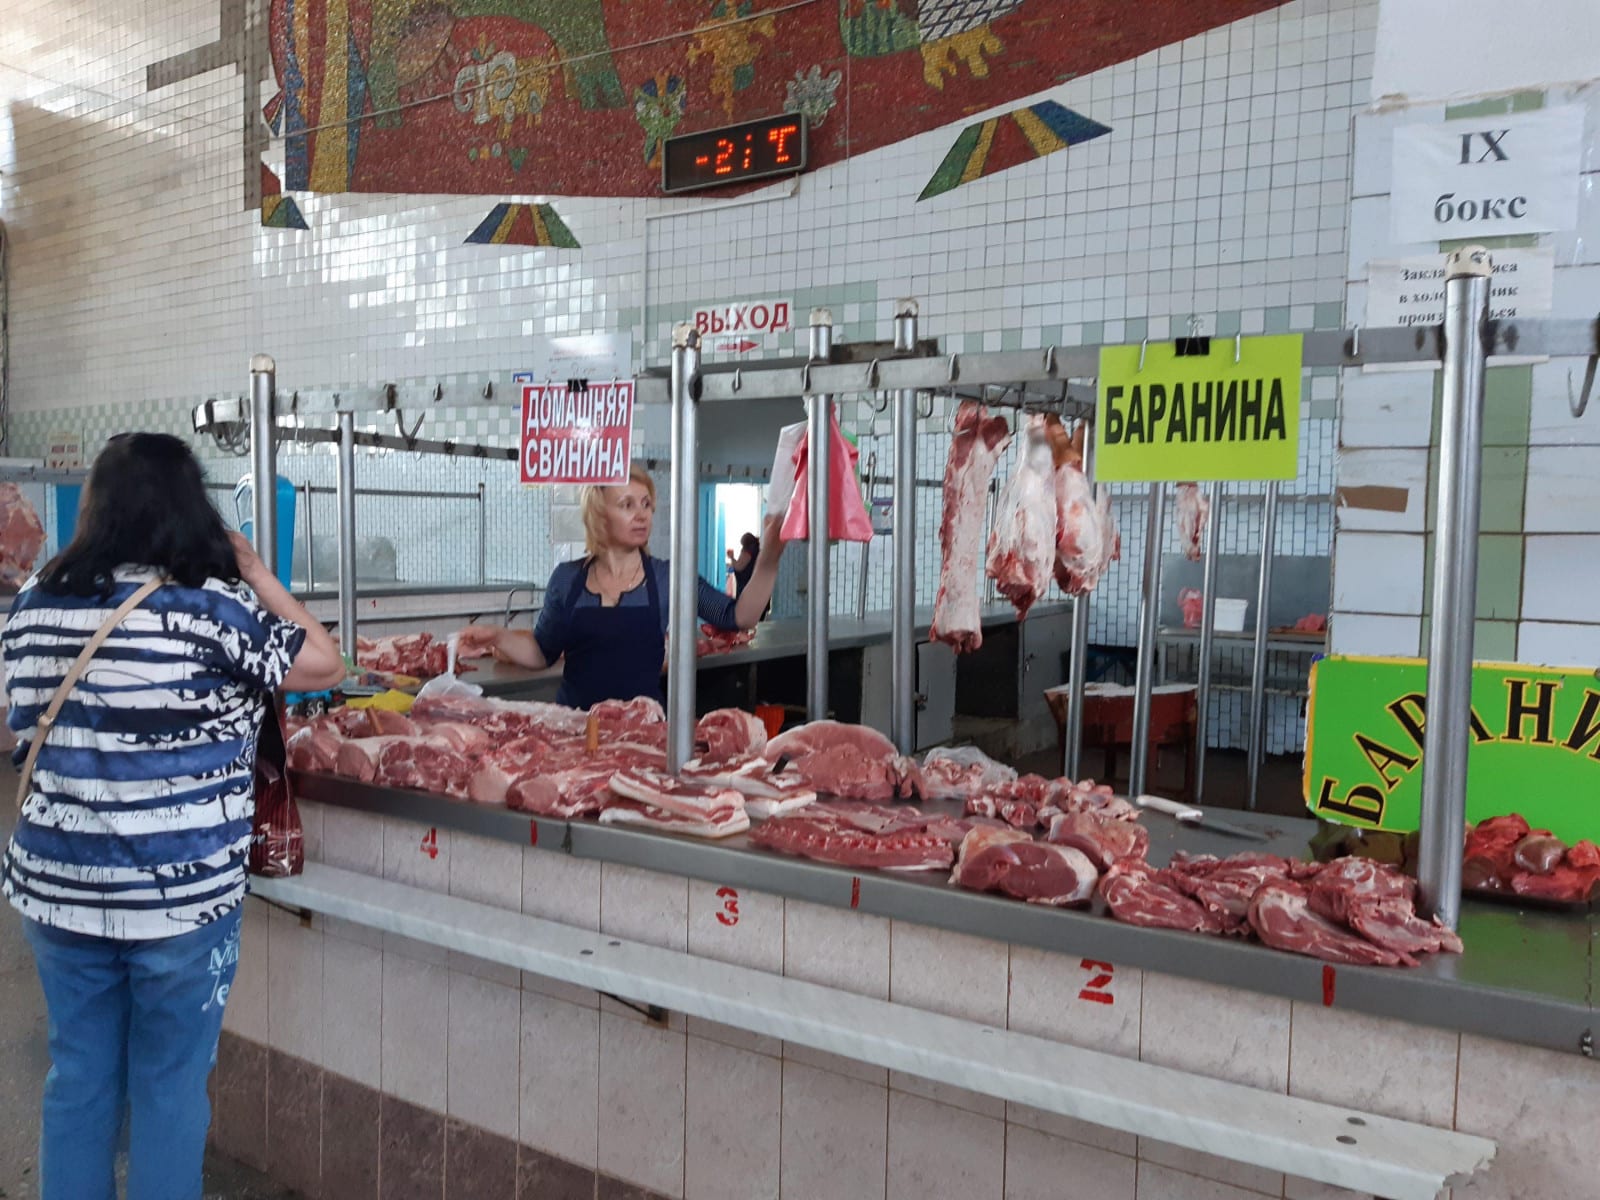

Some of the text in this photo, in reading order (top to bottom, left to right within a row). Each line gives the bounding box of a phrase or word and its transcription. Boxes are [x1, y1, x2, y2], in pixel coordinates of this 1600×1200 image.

[1458, 129, 1510, 165] IX
[1434, 193, 1528, 223] бокс
[695, 302, 789, 335] ВЫХОД
[526, 385, 629, 437] ДОМАШНЯЯ
[1105, 378, 1287, 445] БАРАНИНА
[525, 436, 625, 479] СВИНИНА
[420, 827, 439, 860] 4
[715, 886, 739, 927] 3
[1078, 957, 1115, 1005] 2
